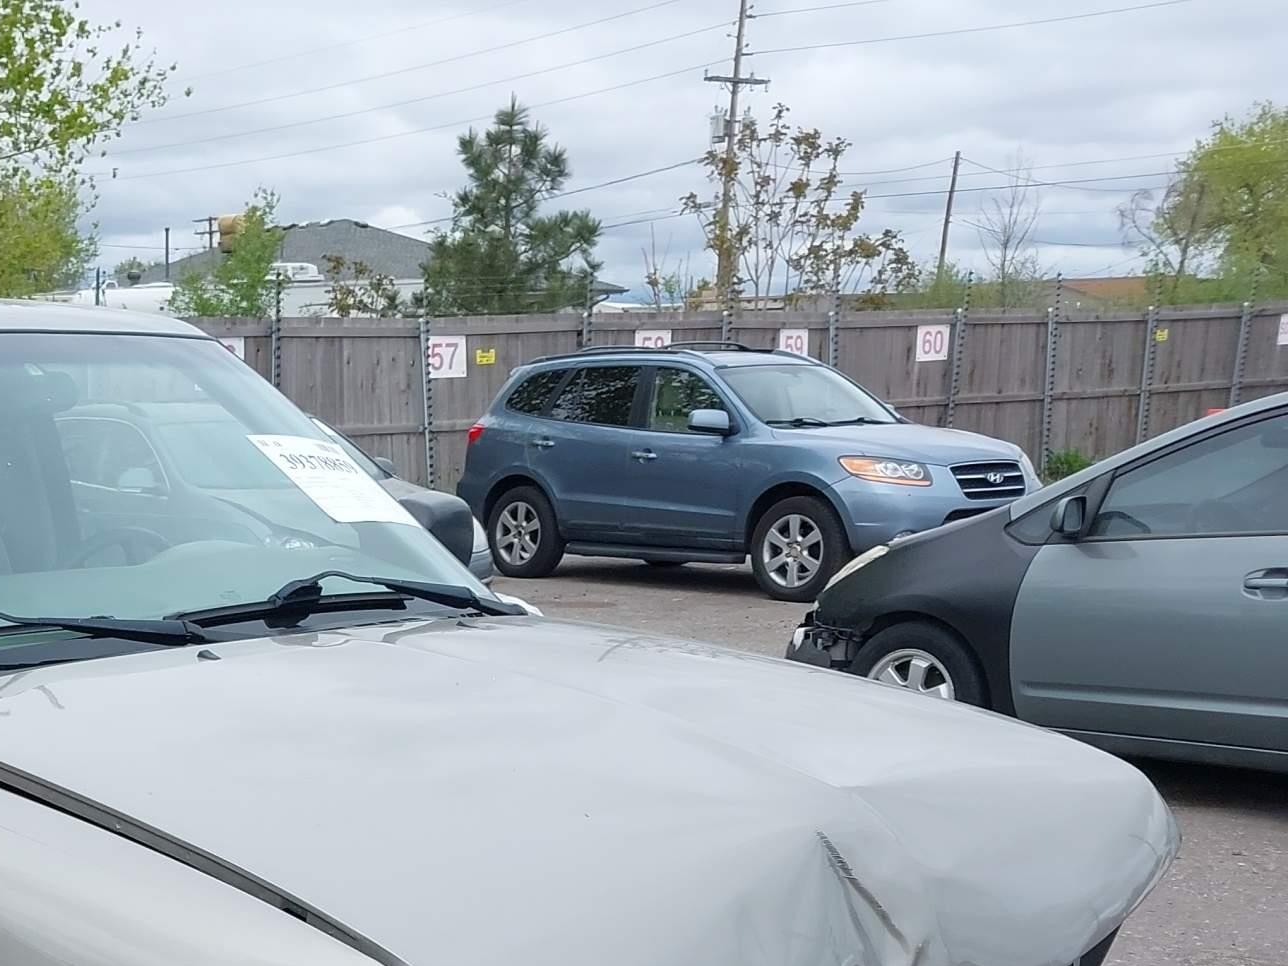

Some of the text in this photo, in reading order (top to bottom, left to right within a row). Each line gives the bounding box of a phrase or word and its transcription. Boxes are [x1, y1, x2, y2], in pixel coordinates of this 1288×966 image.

[785, 335, 804, 355] 59
[922, 331, 943, 354] 60
[431, 343, 459, 371] 57
